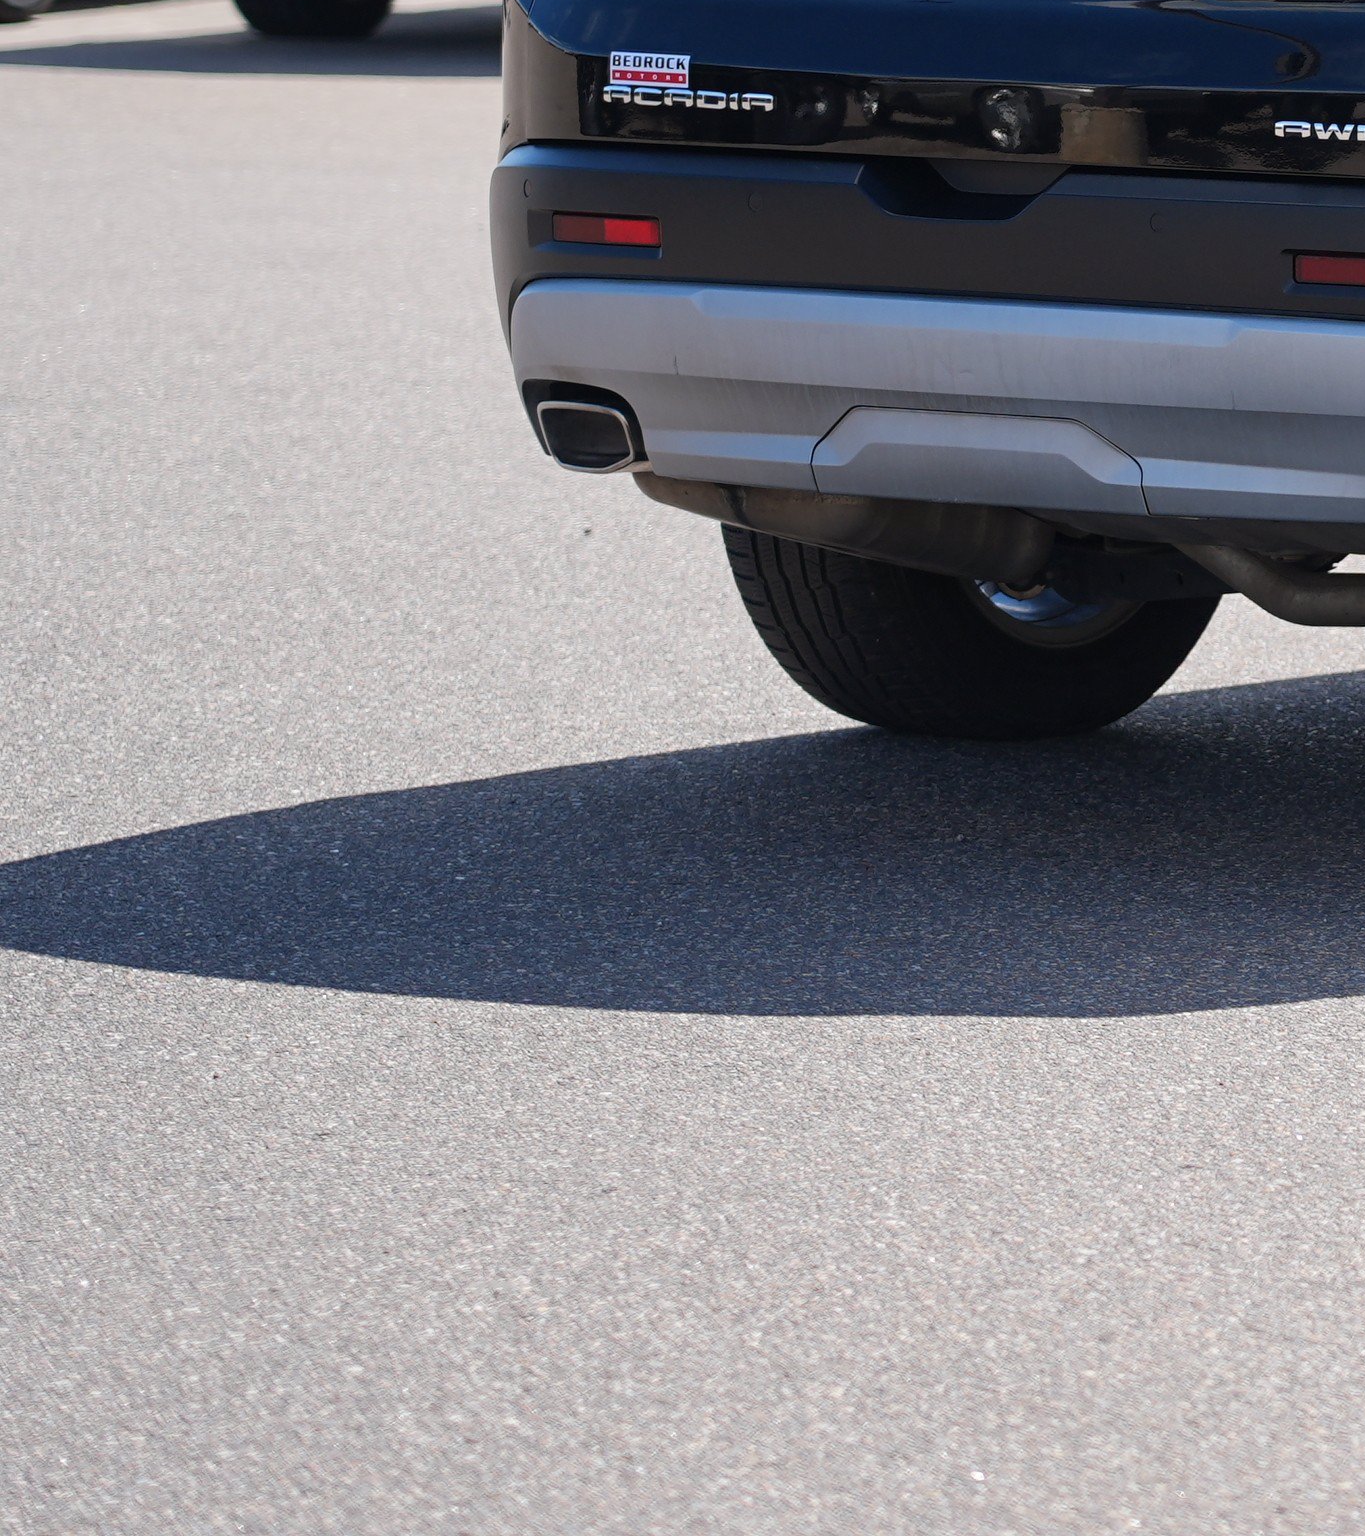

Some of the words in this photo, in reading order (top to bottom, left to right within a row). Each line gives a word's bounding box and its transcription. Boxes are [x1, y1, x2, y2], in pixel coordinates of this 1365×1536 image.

[612, 54, 687, 70] BEDROCK
[614, 70, 685, 82] MOTORS
[603, 85, 774, 111] ACADIA
